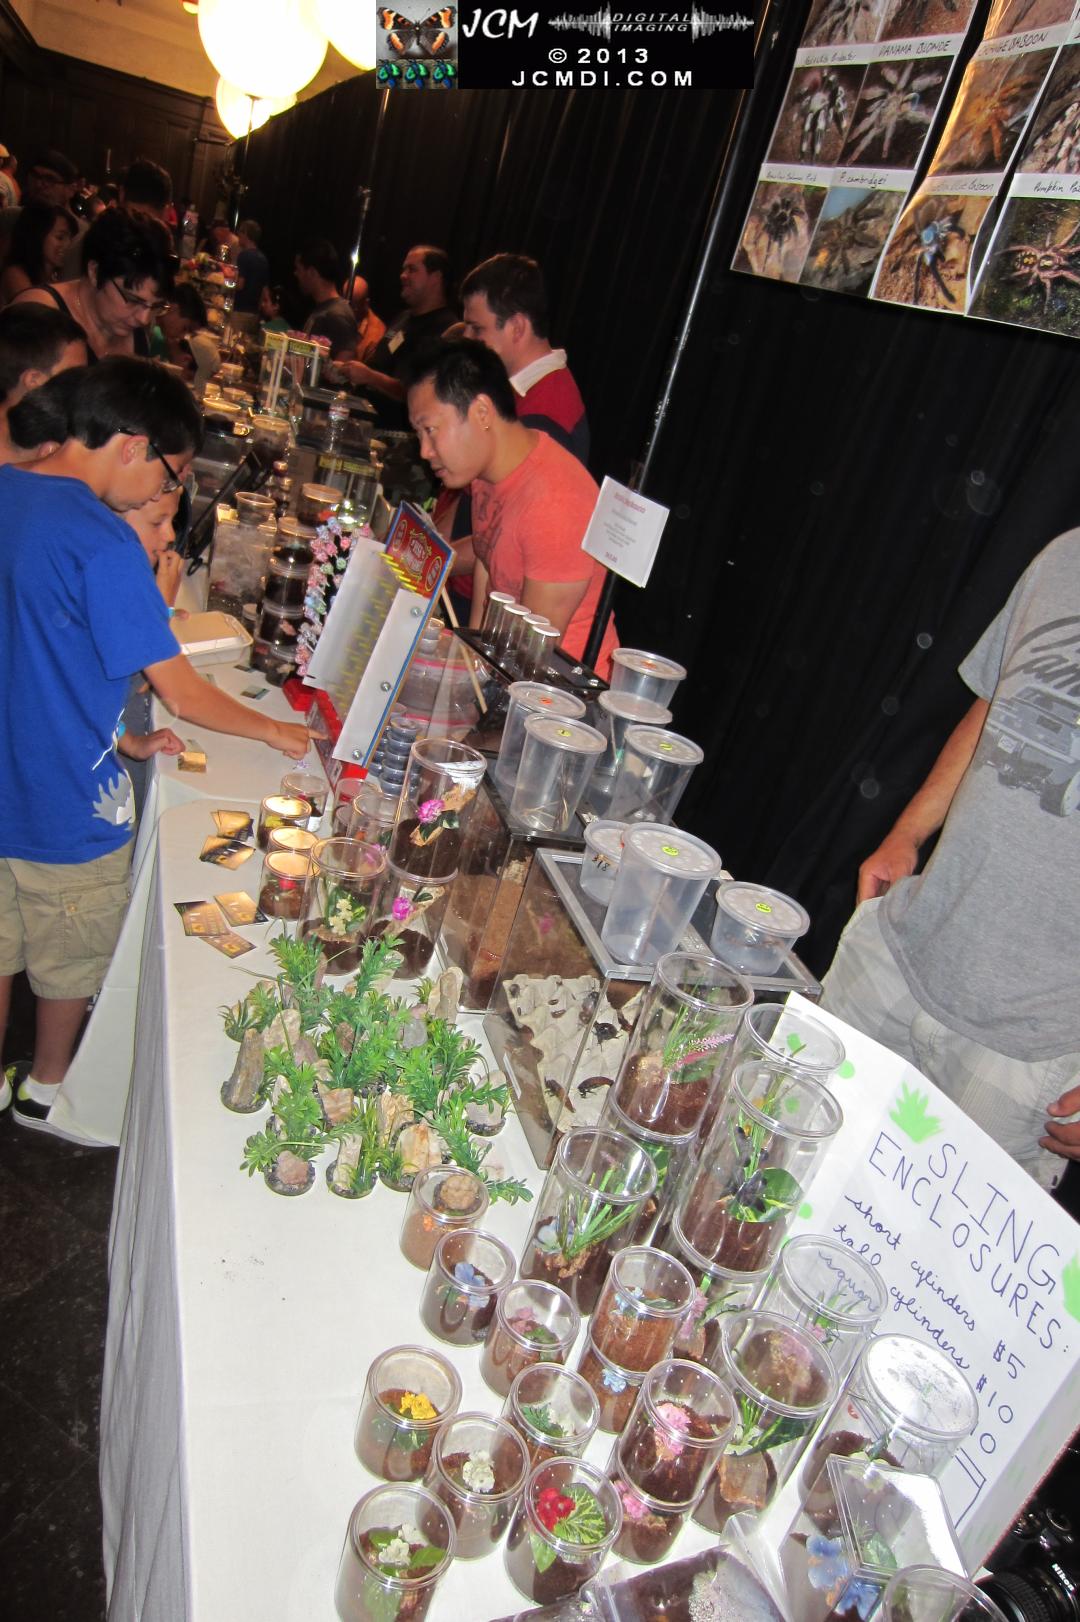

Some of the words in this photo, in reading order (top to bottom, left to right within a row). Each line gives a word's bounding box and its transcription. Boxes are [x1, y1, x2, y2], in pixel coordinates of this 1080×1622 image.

[845, 1195, 902, 1250] short
[911, 1260, 975, 1331] cylinders
[993, 1339, 1026, 1379] $5
[928, 1143, 1060, 1295] SLING
[833, 1224, 882, 1266] tall
[890, 1286, 970, 1370] cylinders
